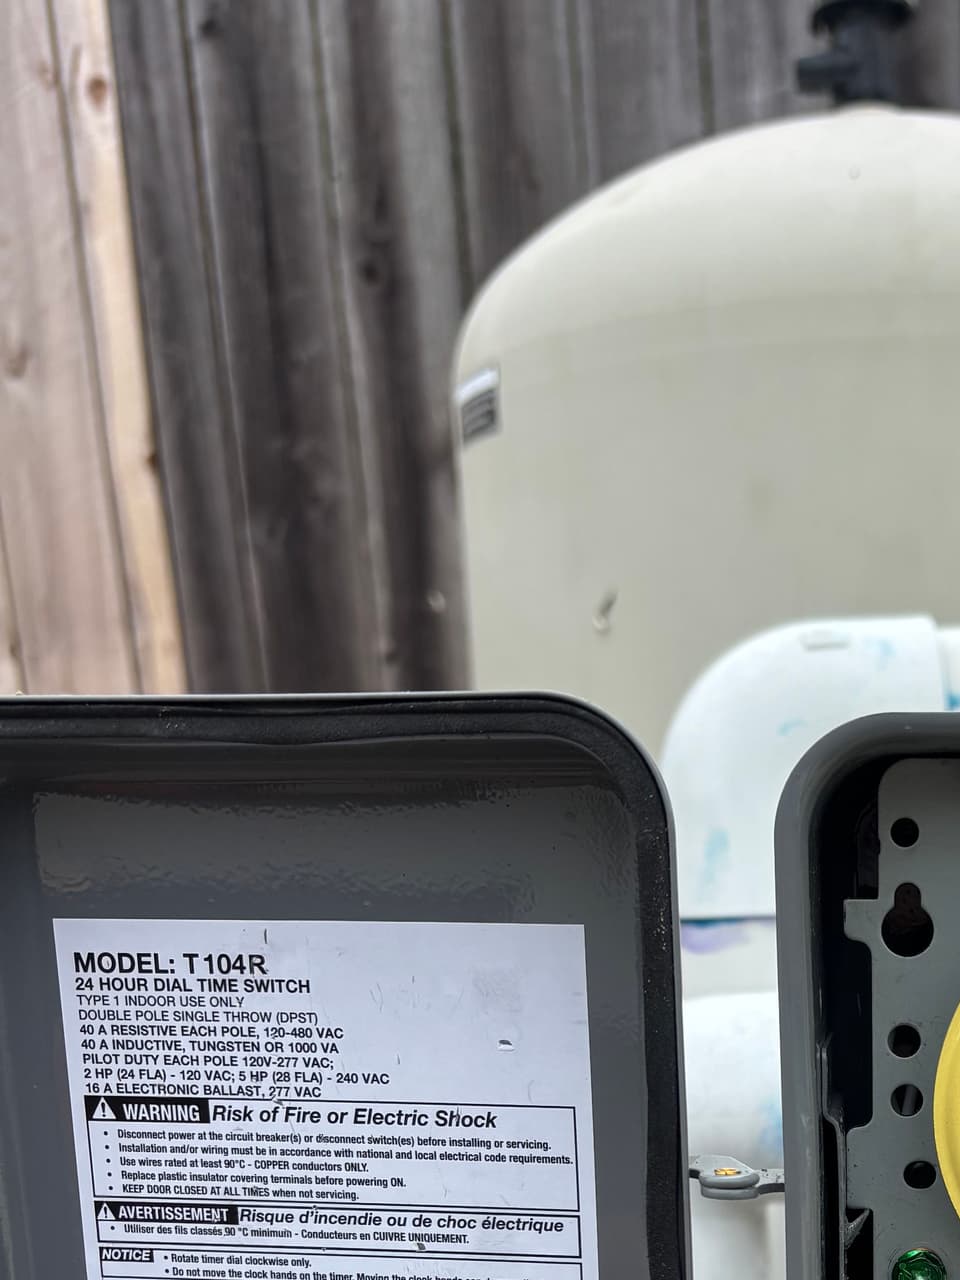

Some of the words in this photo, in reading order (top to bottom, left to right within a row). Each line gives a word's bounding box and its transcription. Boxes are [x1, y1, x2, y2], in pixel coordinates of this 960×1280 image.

[73, 952, 175, 974] MODEL:
[183, 954, 270, 975] T104R
[75, 978, 94, 991] 24
[100, 978, 148, 992] HOUR
[154, 979, 193, 992] DIAL
[197, 979, 238, 993] TIME
[244, 980, 311, 993] SWITCH
[79, 1010, 132, 1021] DOUBLE
[136, 1011, 169, 1022] POLE
[173, 1011, 219, 1022] SINGLE
[223, 1012, 272, 1023] THROW
[276, 1013, 318, 1025] (DPST)
[80, 1026, 94, 1035] 40
[99, 1026, 107, 1036] A
[111, 1026, 177, 1037] RESISTIVE
[181, 1027, 217, 1038] EACH
[222, 1027, 259, 1039] POLE,
[264, 1028, 312, 1038] 120-480
[317, 1029, 344, 1039] VAC
[123, 1103, 200, 1121] WARNING
[212, 1105, 253, 1122] Risk
[260, 1106, 278, 1123] of
[284, 1107, 321, 1124] Fire
[327, 1110, 348, 1125] or
[353, 1108, 429, 1127] Electric
[435, 1110, 497, 1129] Shock
[118, 1206, 228, 1222] AVERTISSEMENT
[240, 1209, 294, 1225] Risque
[387, 1218, 407, 1228] ou
[412, 1215, 432, 1228] de
[437, 1215, 476, 1229] choc
[482, 1216, 564, 1233] électrique
[102, 1248, 150, 1261] NOTICE
